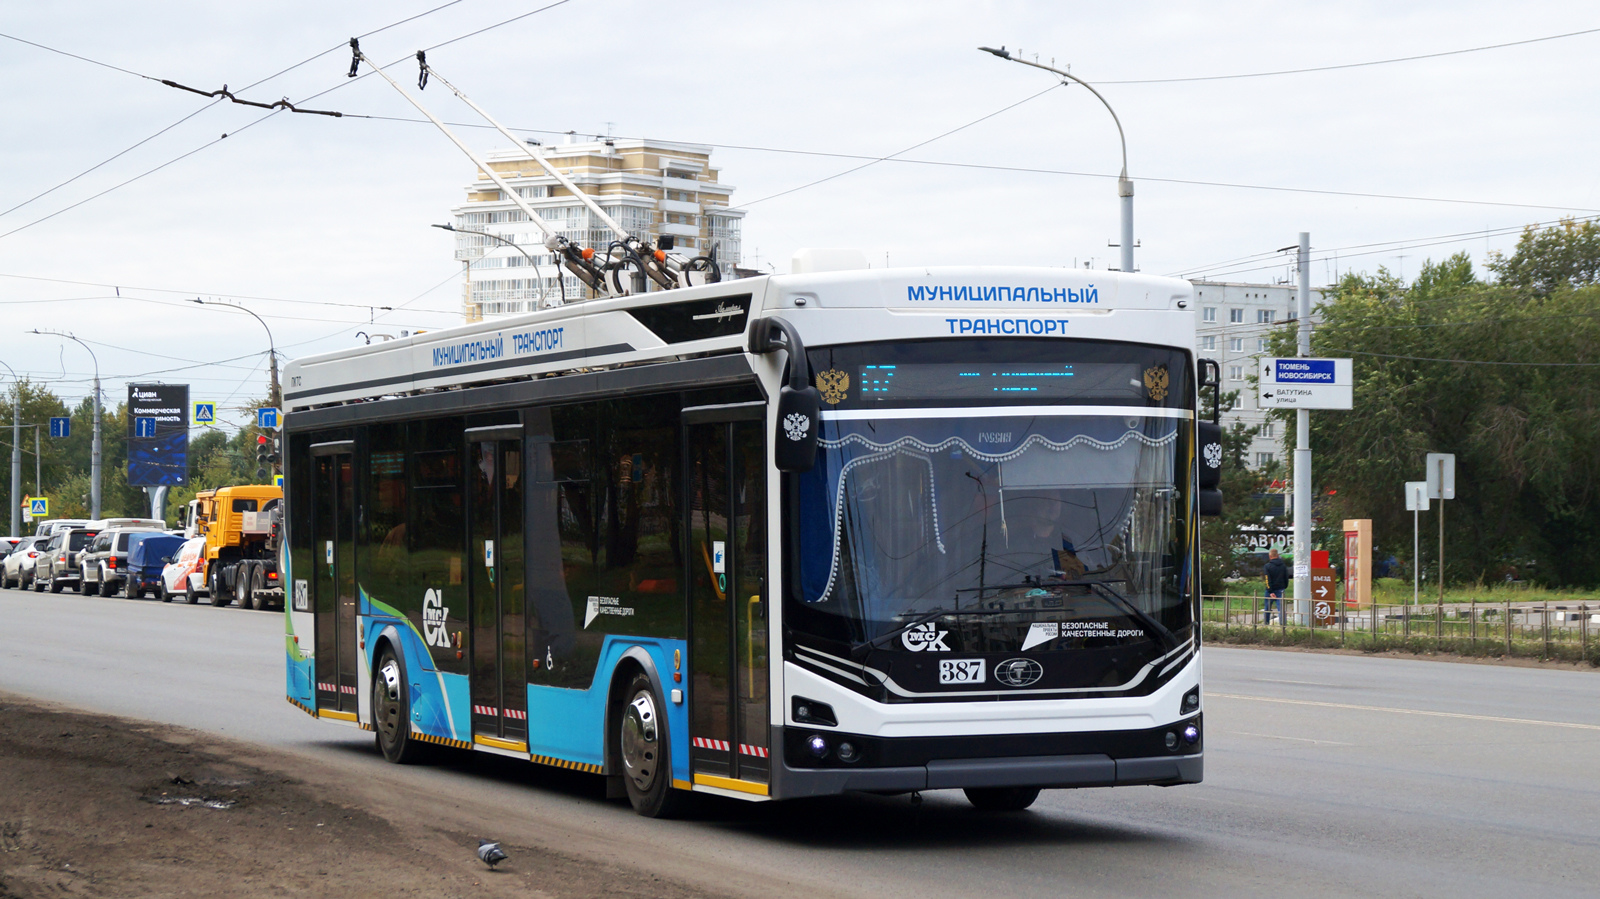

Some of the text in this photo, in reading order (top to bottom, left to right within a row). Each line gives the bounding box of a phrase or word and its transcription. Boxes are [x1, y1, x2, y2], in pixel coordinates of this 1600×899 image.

[907, 284, 1099, 303] МУНИЦИПАЛЬНЫЙ
[945, 319, 1069, 335] ТРАНСПОРТ
[433, 327, 564, 367] МУНИЦИПАЛЬНЫЙ ТРАНСПОРТ
[1278, 363, 1310, 371] ТЮМЕНЬ
[1278, 372, 1332, 380] НОВОСИБИРСК
[134, 407, 181, 415] Коммерческая
[1061, 621, 1109, 630] БЕЗОПАСНЫЕ
[1061, 629, 1144, 638] КАЧЕСТВЕННЫЕ ДОРОГИ
[941, 661, 981, 681] 387
